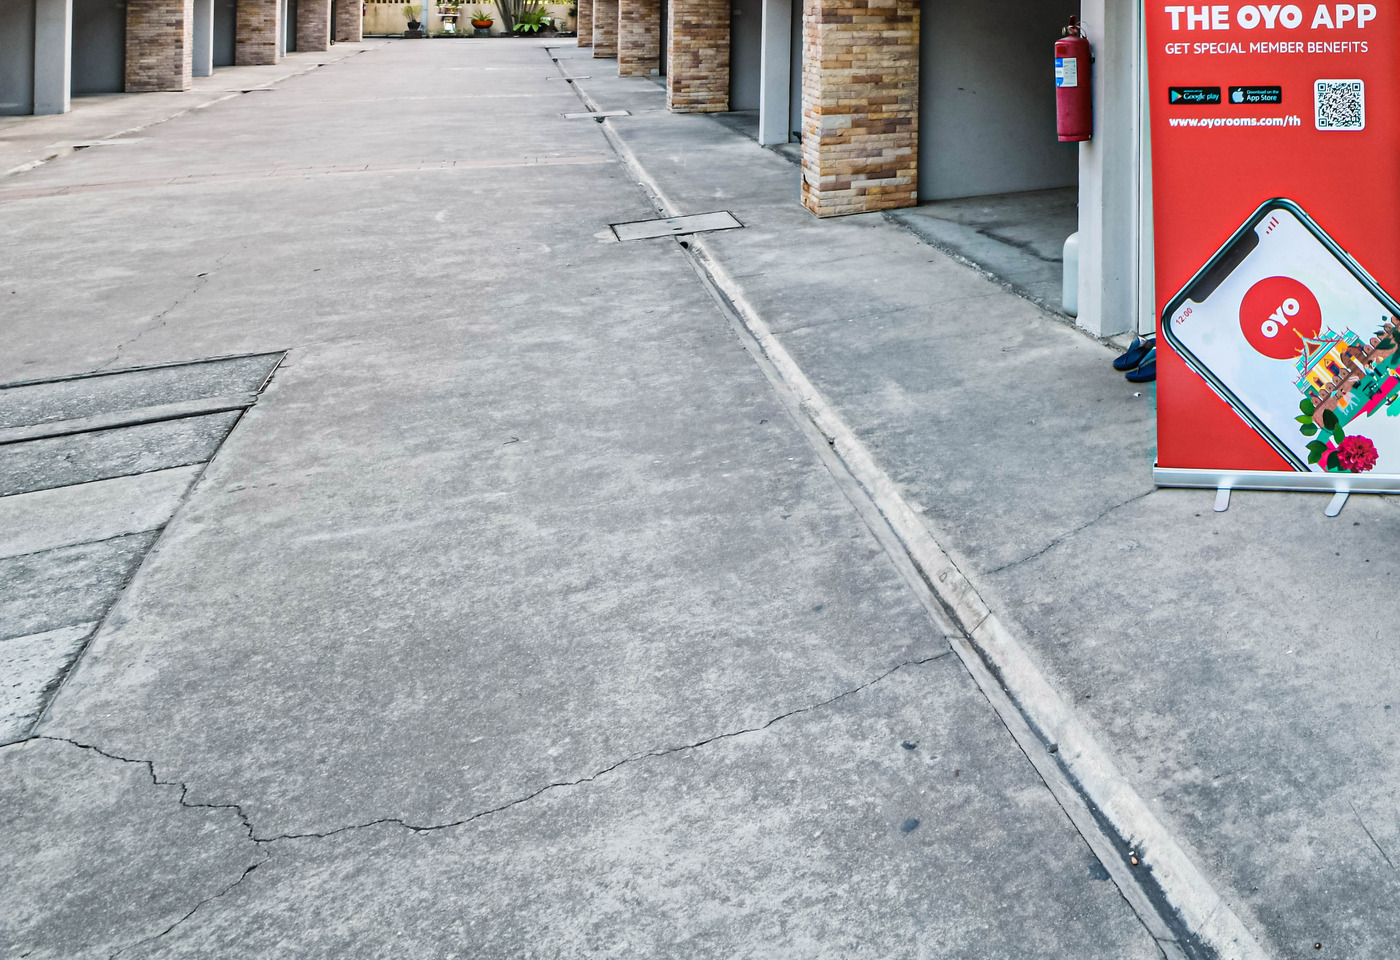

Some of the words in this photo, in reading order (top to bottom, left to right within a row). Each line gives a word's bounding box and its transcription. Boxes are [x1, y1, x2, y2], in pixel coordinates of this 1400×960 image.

[1165, 5, 1230, 30] THE
[1236, 4, 1303, 29] OYO
[1311, 3, 1377, 29] APP
[1165, 43, 1190, 54] GET
[1193, 43, 1246, 54] SPECIAL
[1250, 42, 1304, 54] MEMBER
[1308, 41, 1368, 53] BENEFITS
[1183, 92, 1205, 102] Google
[1207, 93, 1219, 101] play
[1169, 115, 1301, 129] www.oyorooms.com/th
[1175, 307, 1193, 325] 12:00
[1261, 298, 1300, 338] OYO
